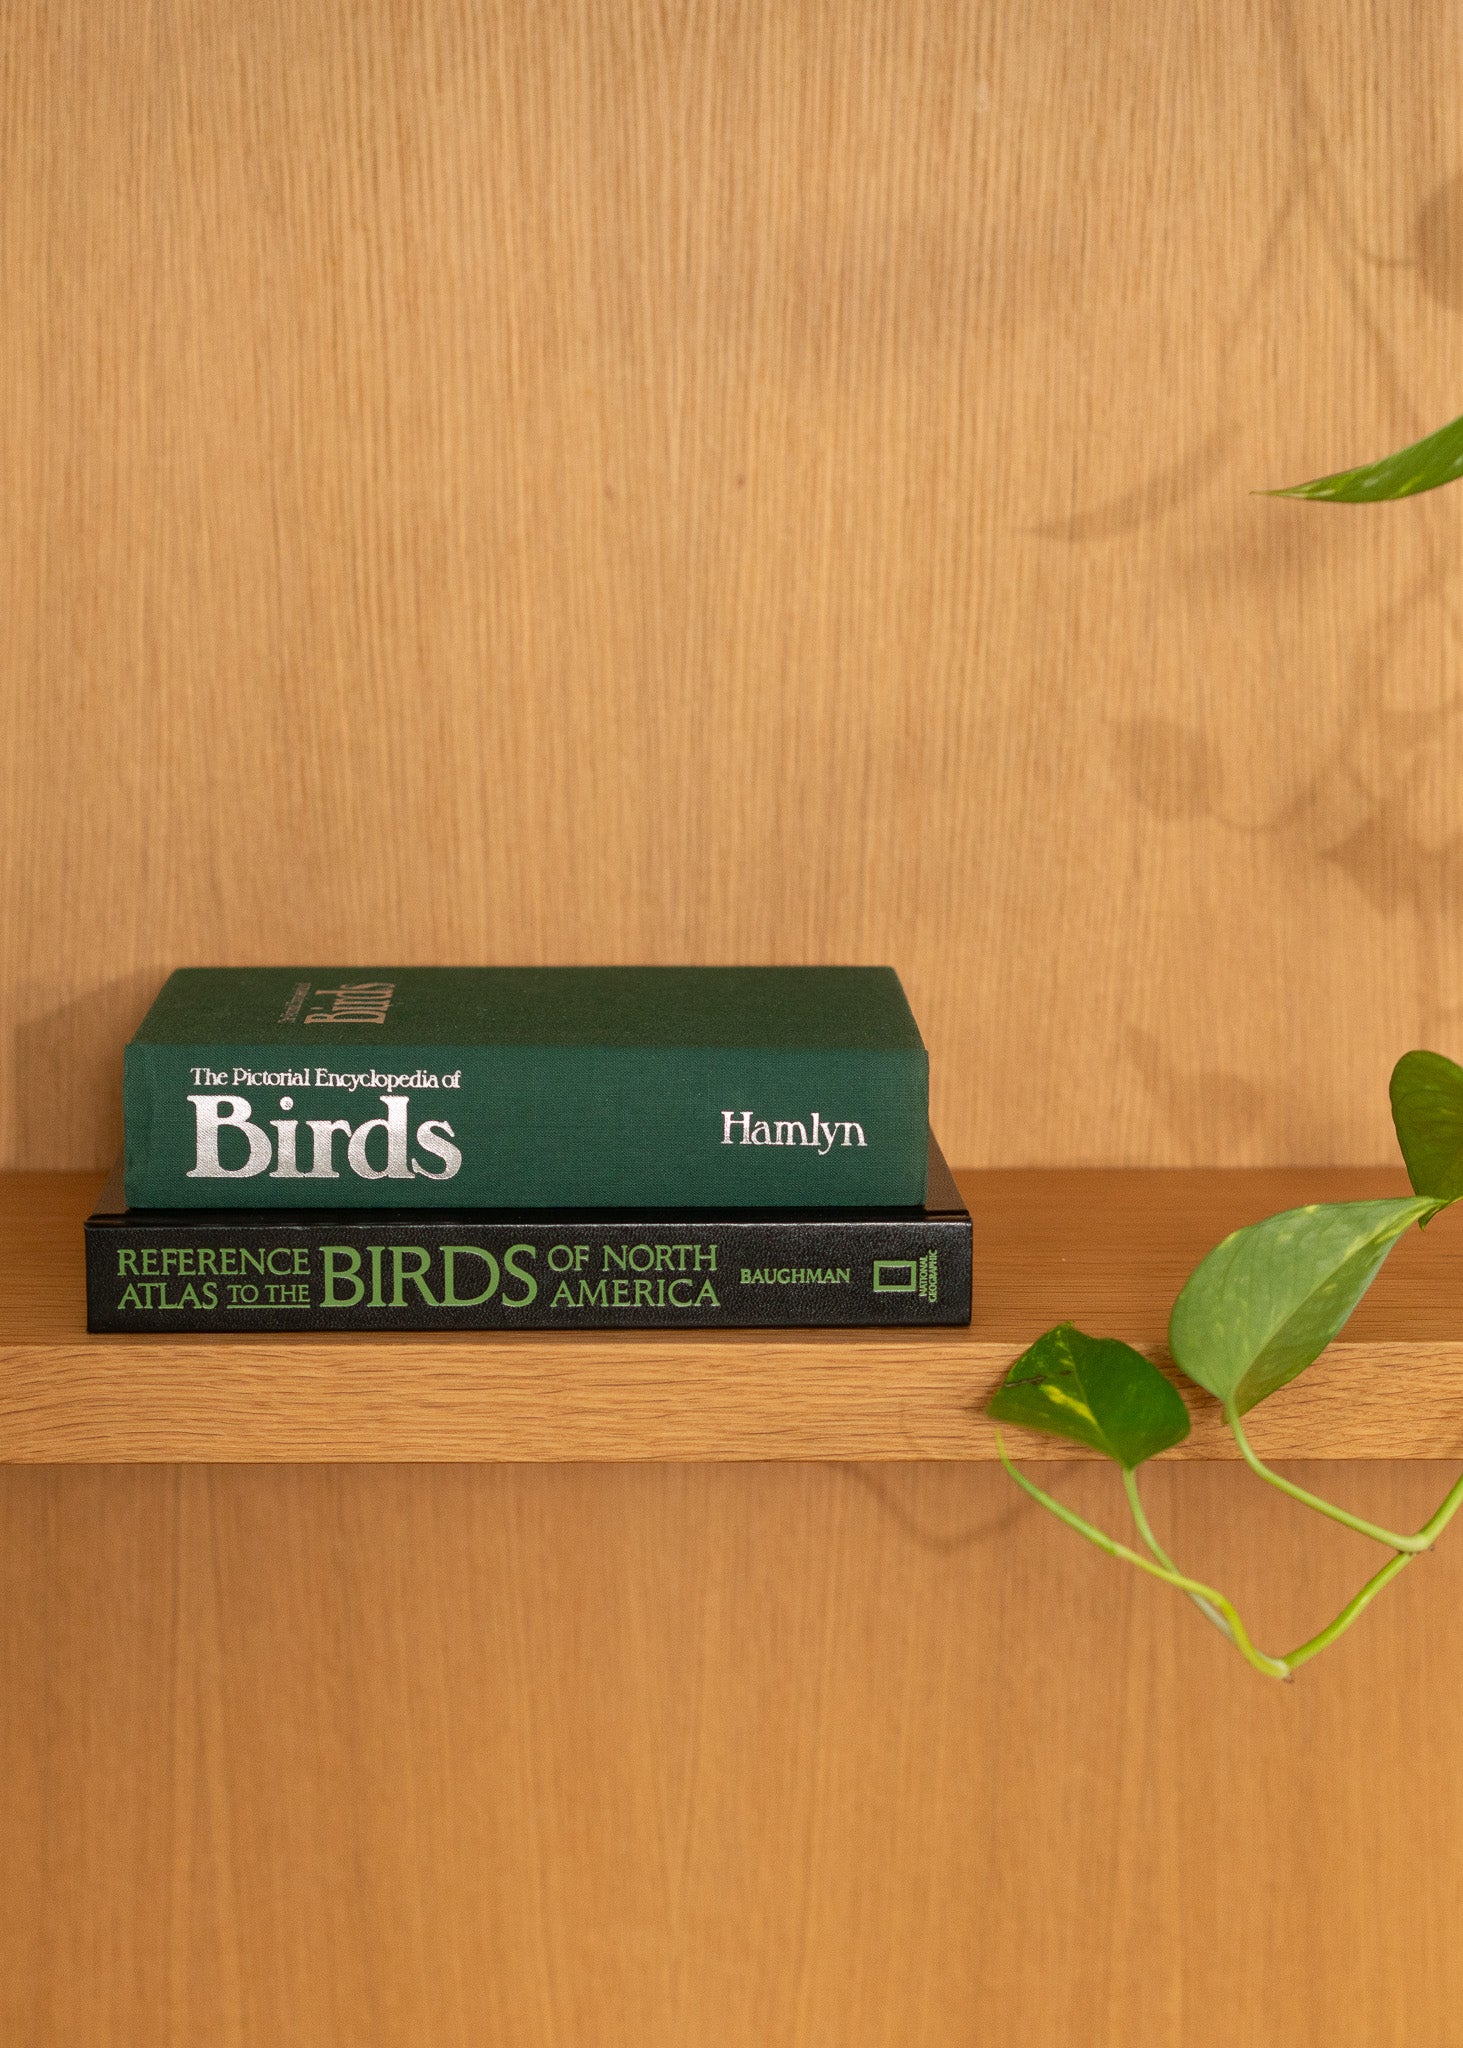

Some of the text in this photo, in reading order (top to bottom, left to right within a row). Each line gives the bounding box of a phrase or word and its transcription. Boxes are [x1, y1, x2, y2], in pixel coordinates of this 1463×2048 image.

[304, 982, 396, 1024] Birds
[190, 1067, 461, 1092] The Pictorial Encyclopedia of
[186, 1094, 463, 1180] Birds
[720, 1110, 868, 1156] Hamlyn
[116, 1248, 311, 1276] REFERENCE
[319, 1243, 539, 1308] BIRDS
[547, 1245, 719, 1272] OF NORTH
[739, 1267, 852, 1285] BAUGHMAN
[919, 1254, 929, 1297] NATIONAL
[928, 1249, 938, 1303] GEOGRAPHIC
[116, 1281, 311, 1310] ATLAS TO THE
[549, 1278, 721, 1308] AMERICA
